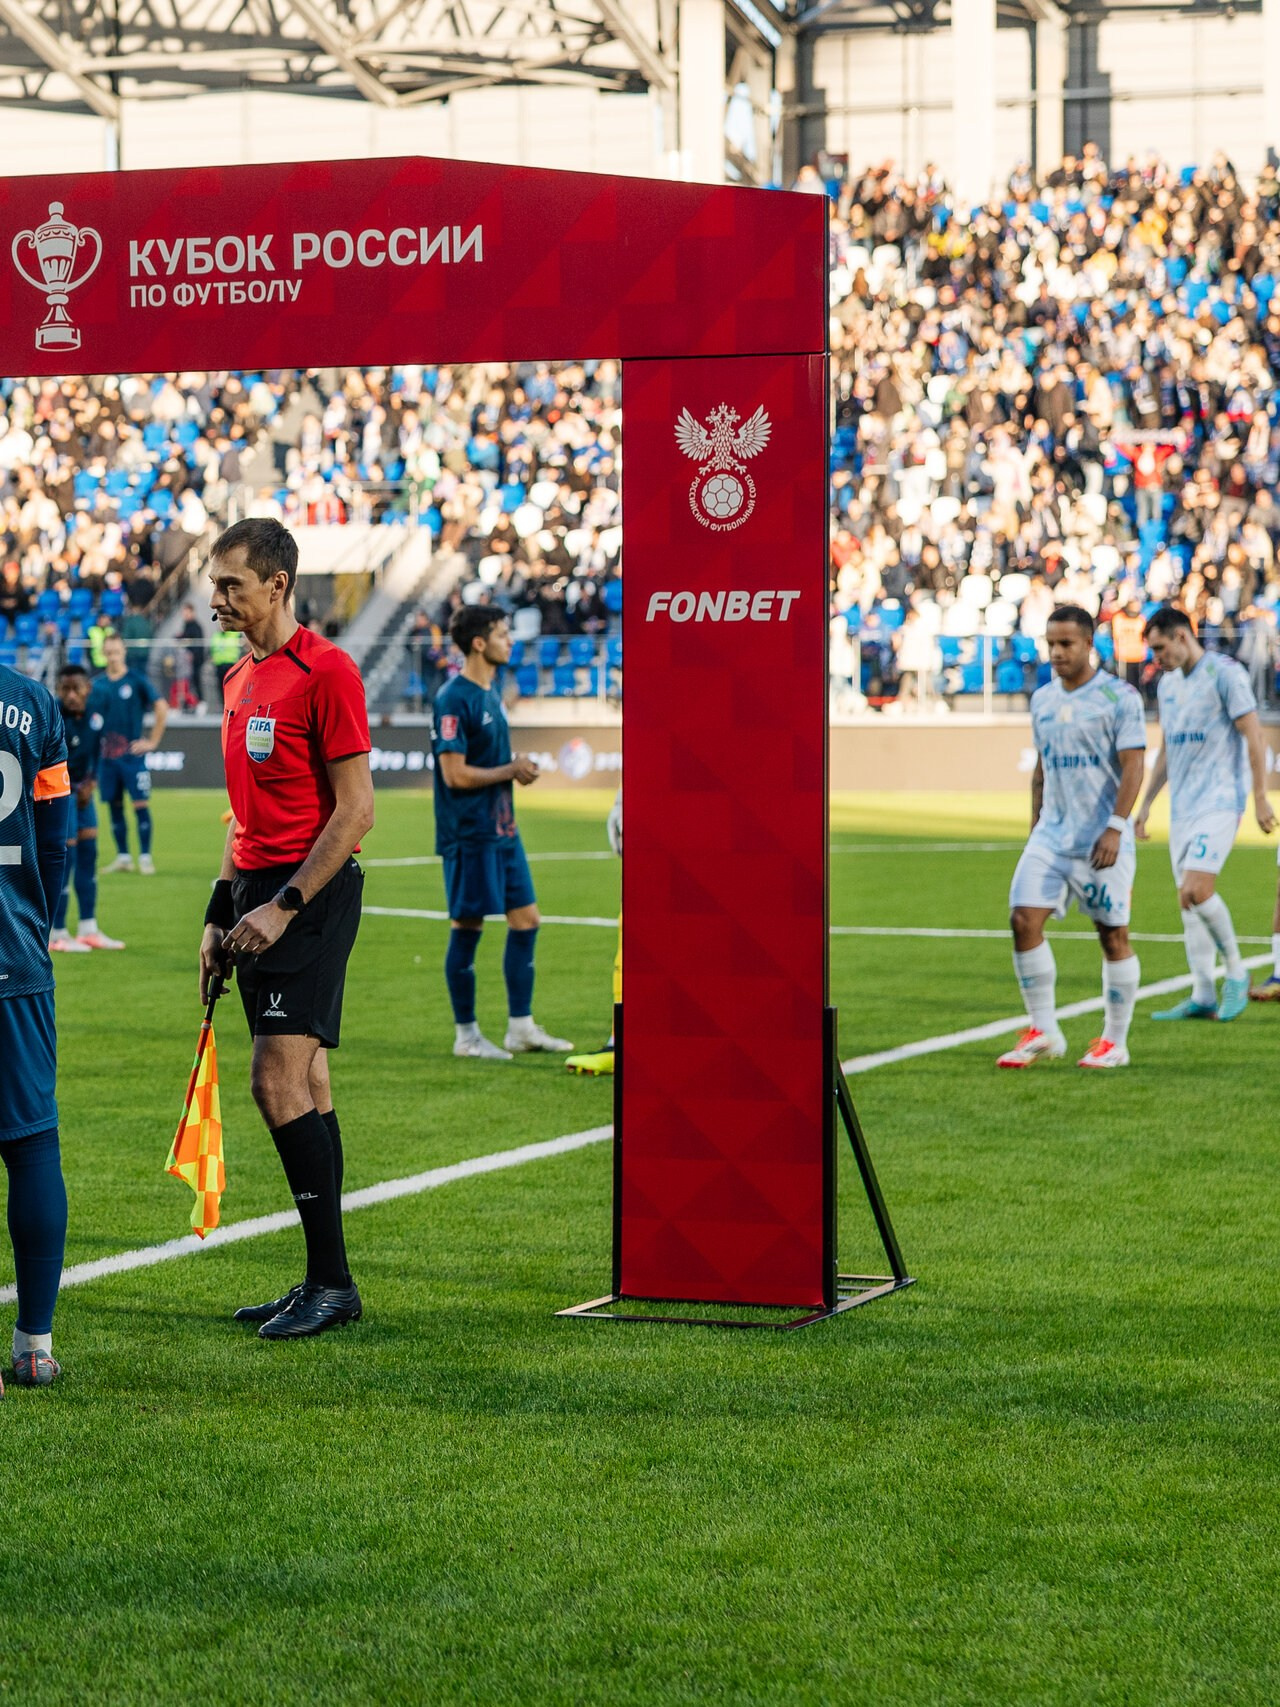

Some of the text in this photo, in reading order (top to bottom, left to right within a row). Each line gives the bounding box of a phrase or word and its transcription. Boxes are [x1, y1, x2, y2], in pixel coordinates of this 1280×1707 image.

[129, 225, 483, 277] КУБОК РОССИИ
[130, 279, 302, 307] ПО ФУТБОЛУ
[689, 474, 757, 532] РОССИЙСКИЙ ФУТБОЛЬНЫЙ СОЮЗ
[645, 590, 801, 623] FONBET
[249, 719, 272, 733] FIFA
[1083, 882, 1112, 912] 24
[262, 1009, 287, 1017] JÖGEL
